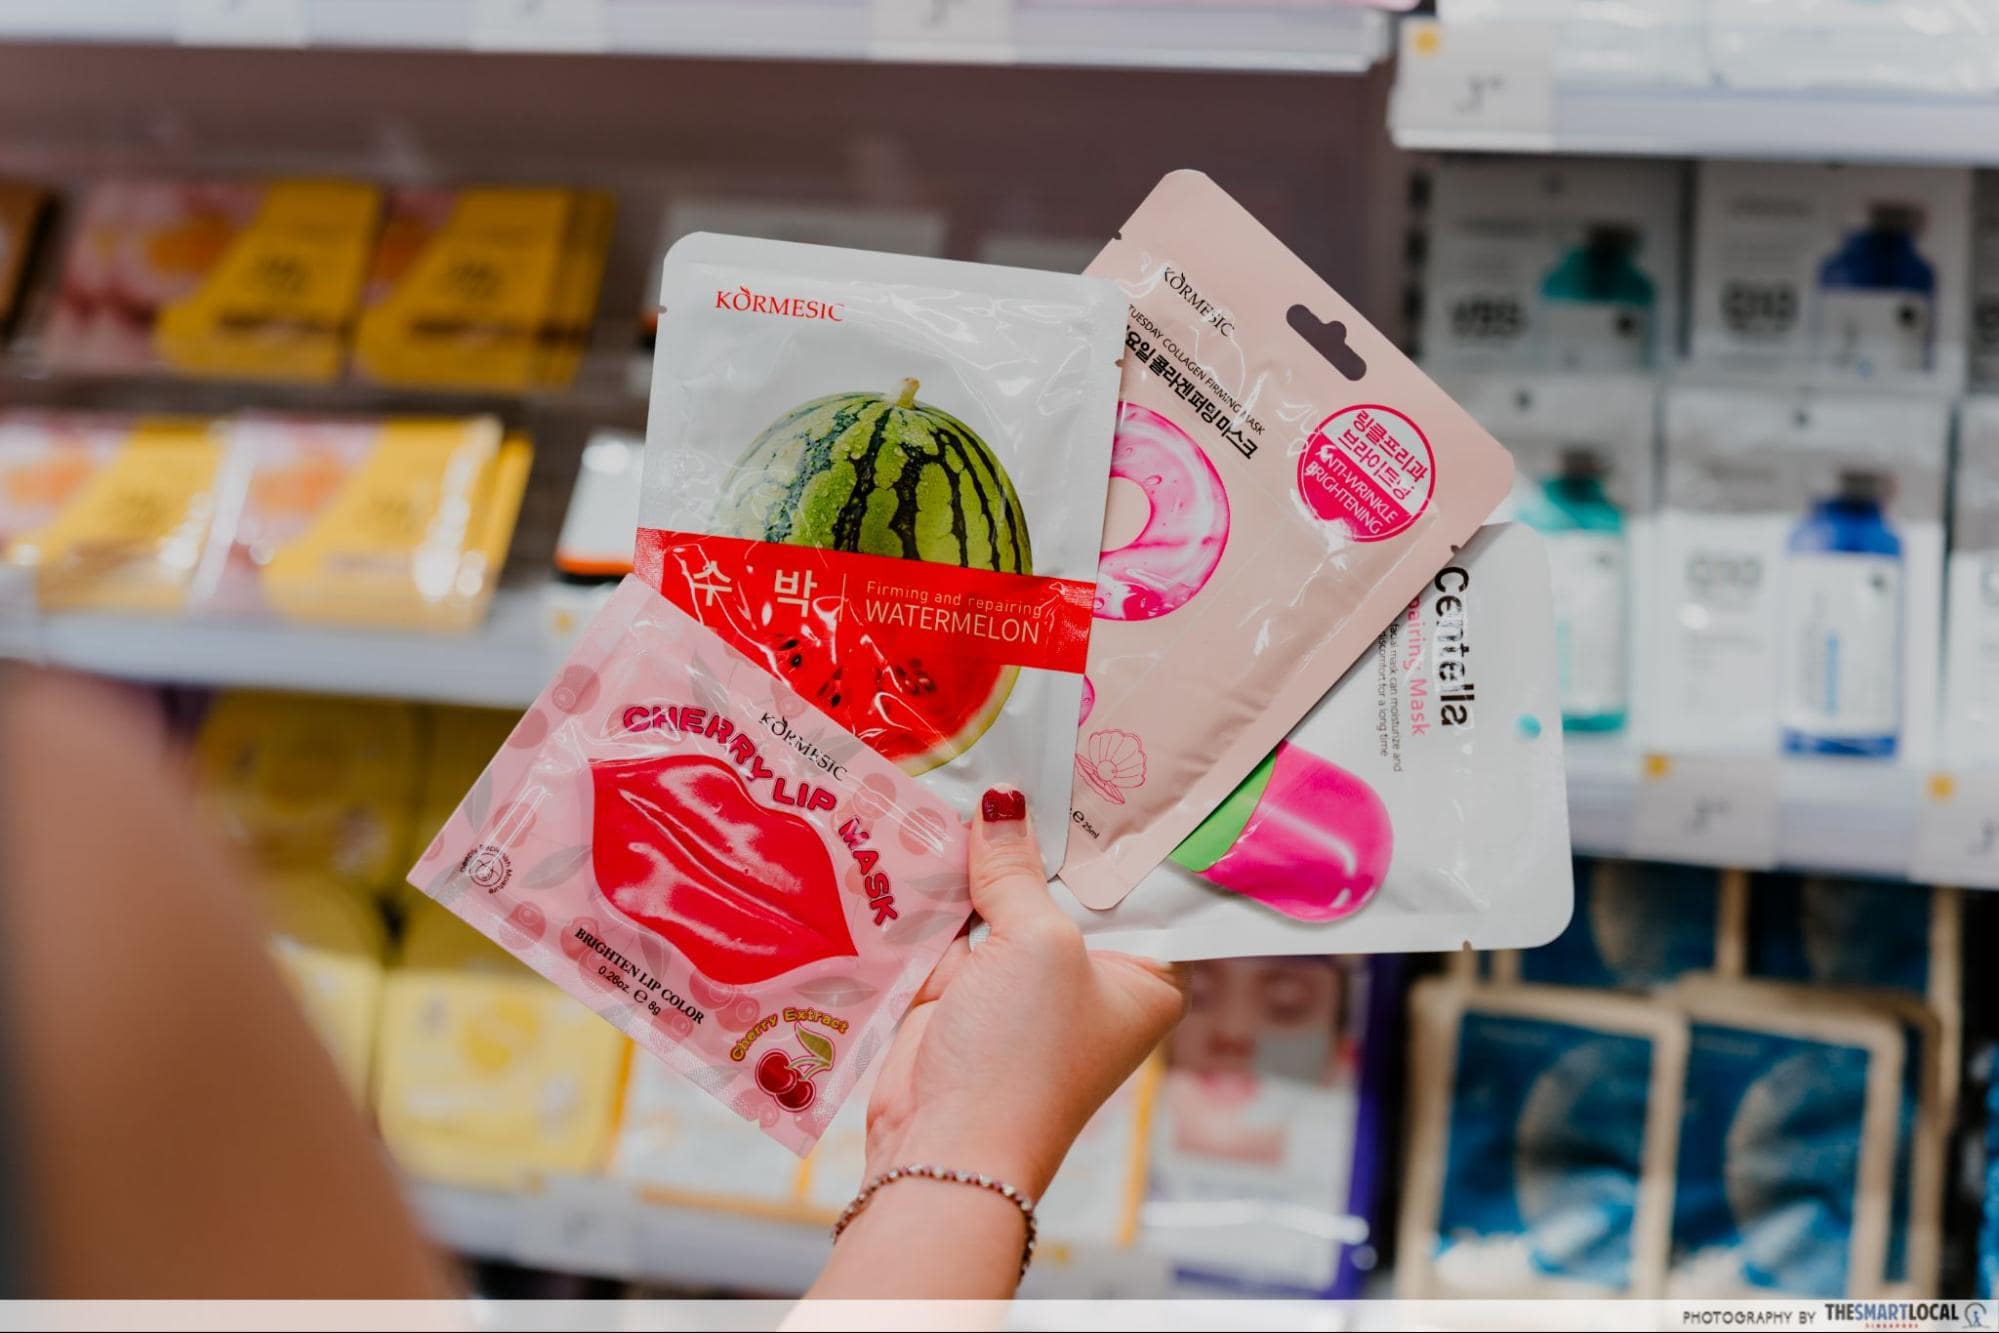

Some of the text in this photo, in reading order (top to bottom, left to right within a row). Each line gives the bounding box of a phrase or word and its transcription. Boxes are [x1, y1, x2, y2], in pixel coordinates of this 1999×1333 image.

[1128, 304, 1165, 340] TUESDAY
[1162, 338, 1207, 381] COLLAGEN
[1204, 377, 1243, 414] FIRMING
[1125, 325, 1259, 461] 요일 콜라겐 퍼딩 마스크
[1353, 410, 1428, 483] 링클프리과
[773, 569, 818, 618] 박
[866, 580, 1043, 619] Firming and repairing
[865, 599, 1041, 645] WATERMELON
[1408, 678, 1432, 736] Mask
[1393, 752, 1403, 772] and
[623, 706, 898, 927] CHERRY LIP MASK
[574, 927, 705, 1025] BRIGHTEN LIP COLOR
[647, 1000, 662, 1016] 8g
[730, 1007, 849, 1062] Cherry Extract
